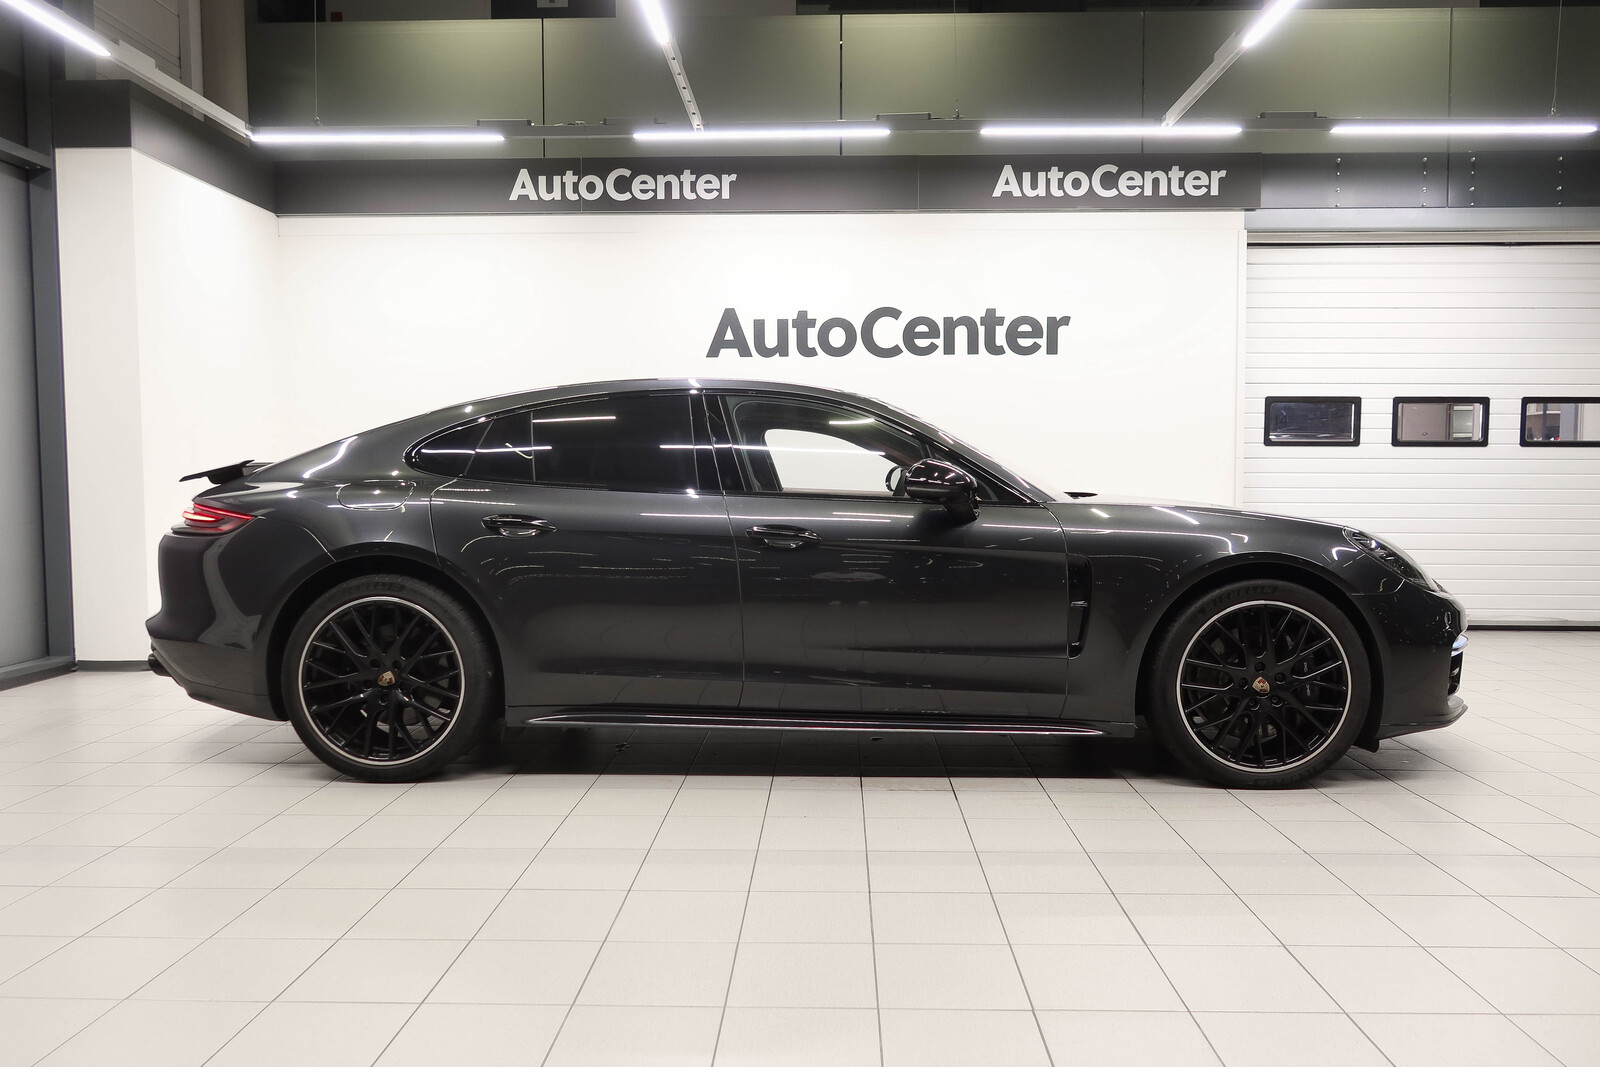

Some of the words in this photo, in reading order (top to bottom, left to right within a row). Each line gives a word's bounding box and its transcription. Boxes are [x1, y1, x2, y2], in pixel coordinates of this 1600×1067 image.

[509, 169, 736, 201] AutoCenter
[992, 165, 1226, 197] AutoCenter
[706, 307, 1070, 358] AutoCenter
